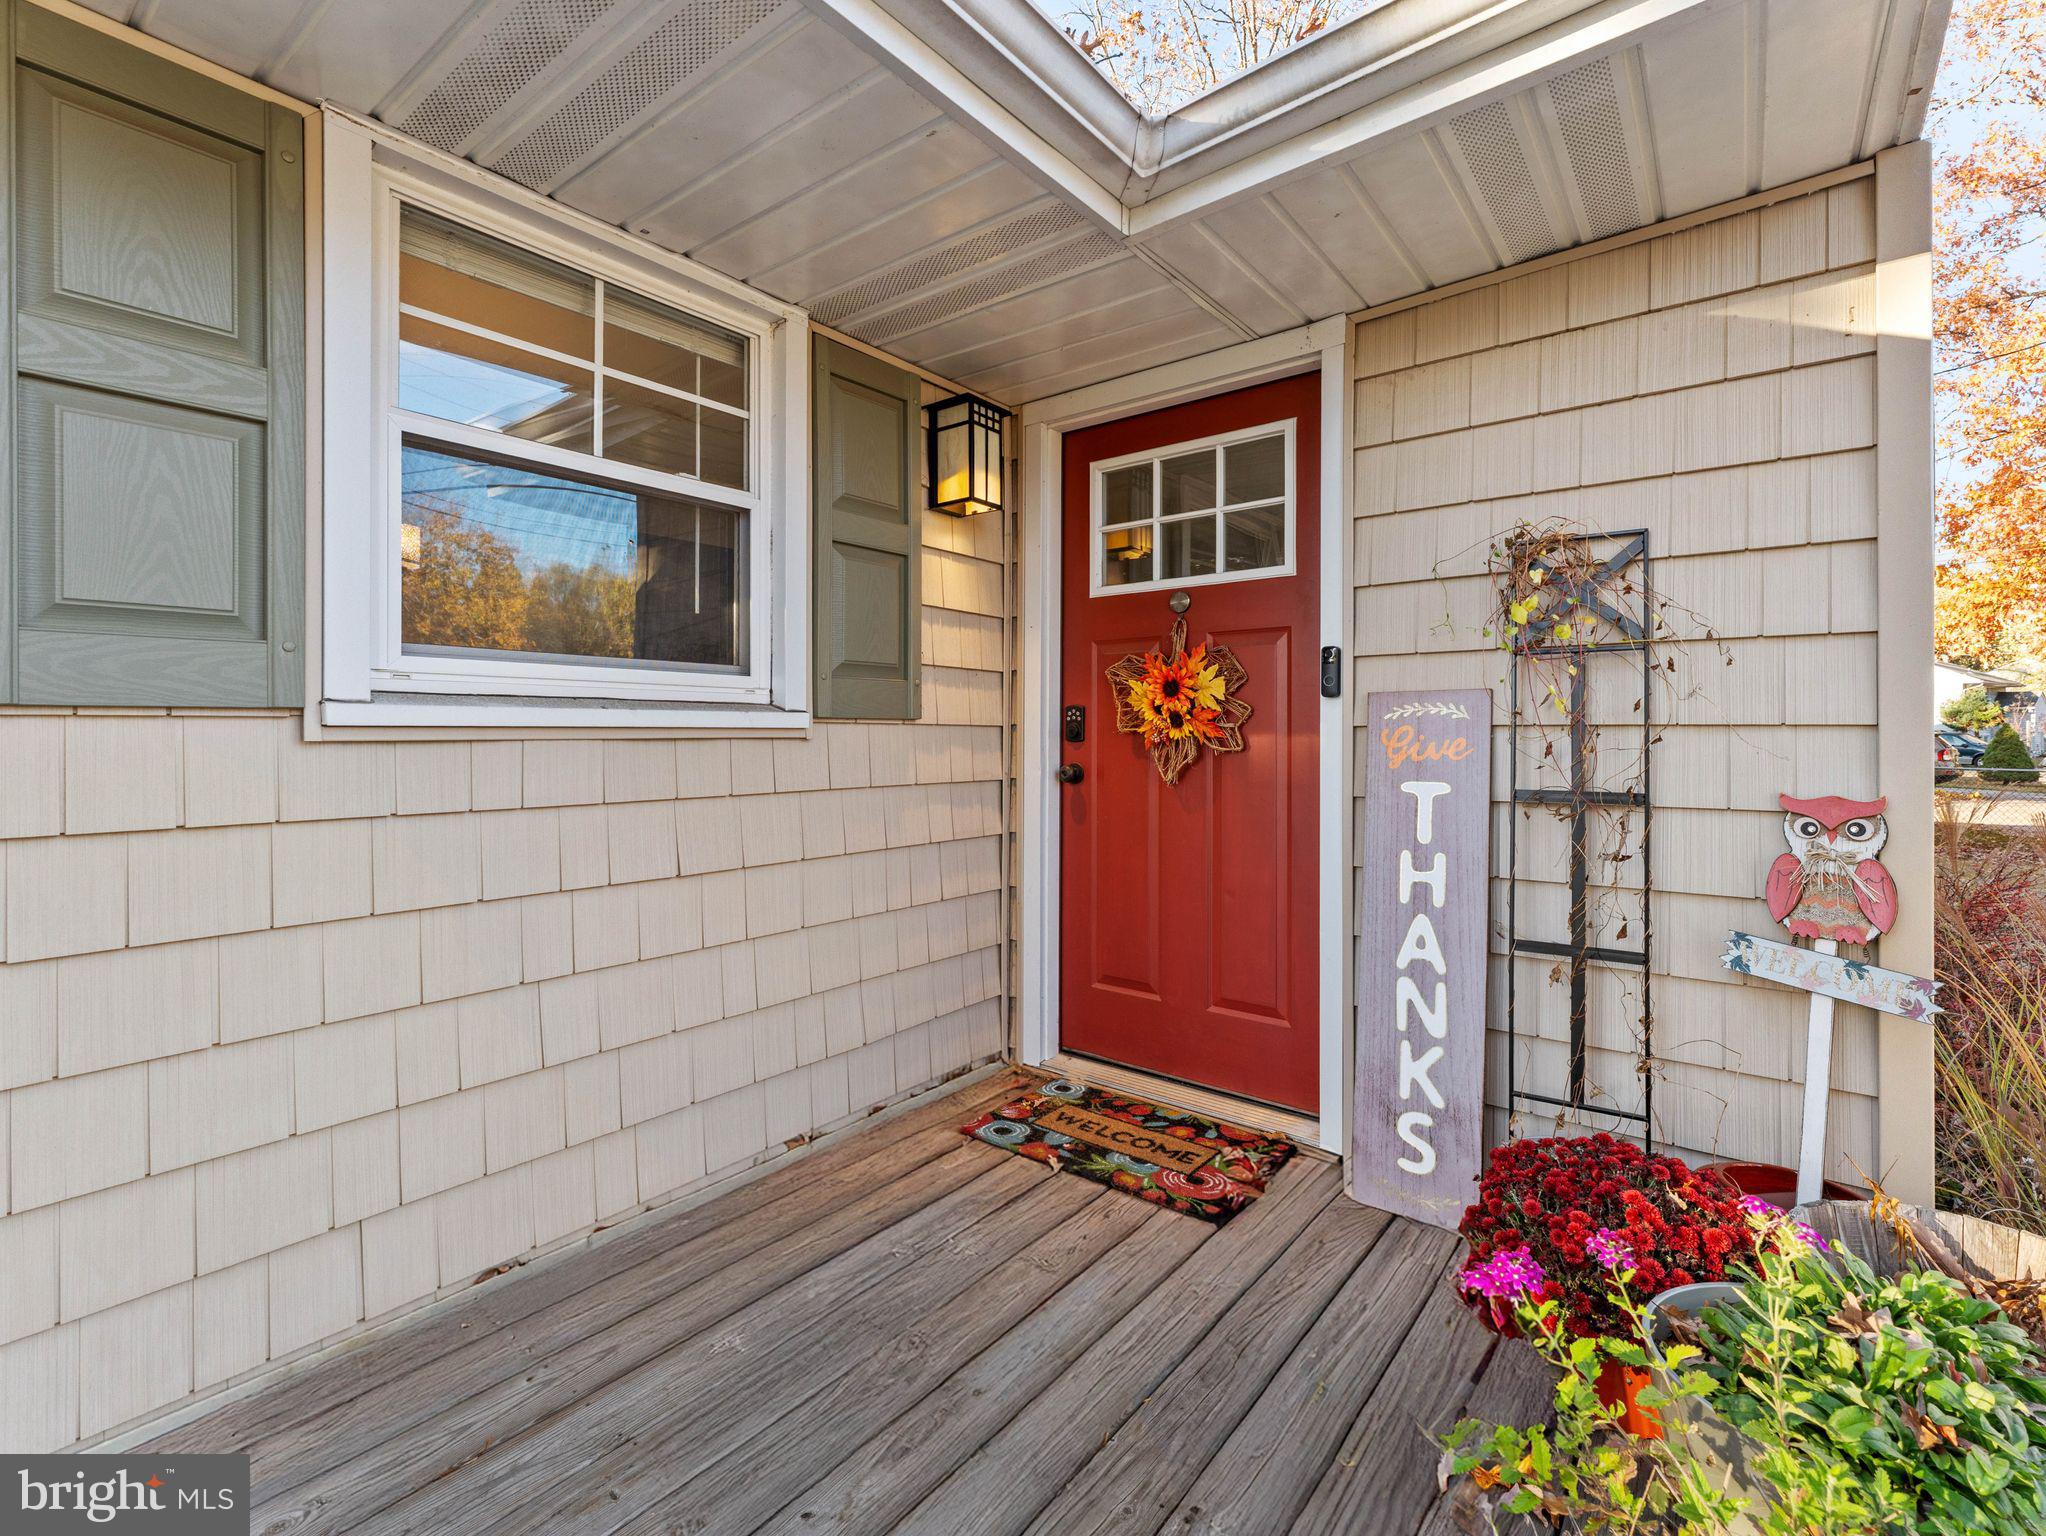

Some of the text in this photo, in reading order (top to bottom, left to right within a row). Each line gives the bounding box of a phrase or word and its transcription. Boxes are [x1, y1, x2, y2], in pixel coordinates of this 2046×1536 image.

[1380, 724, 1475, 769] Give
[1396, 781, 1452, 1176] THANKS
[1055, 1111, 1200, 1165] WELCOME
